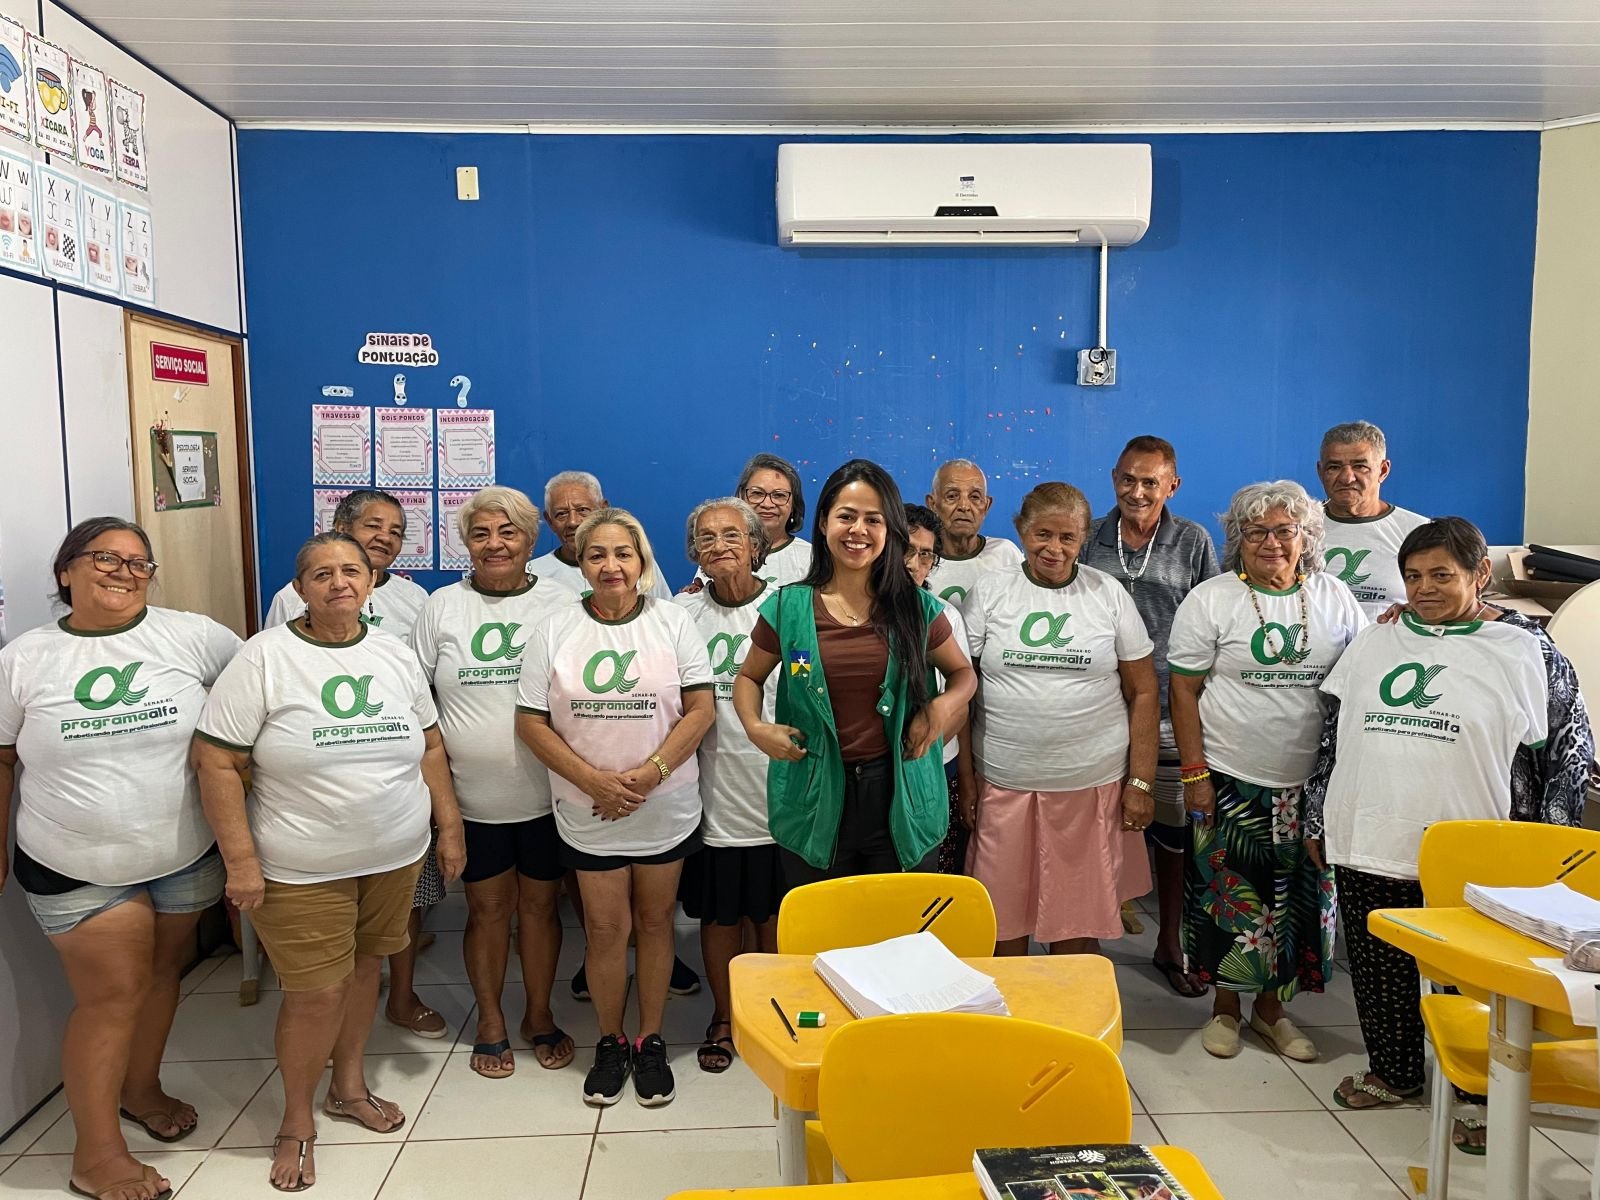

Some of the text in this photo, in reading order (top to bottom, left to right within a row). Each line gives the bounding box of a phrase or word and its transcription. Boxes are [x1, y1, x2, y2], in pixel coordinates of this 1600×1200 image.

[0, 95, 19, 114] I-FI
[85, 145, 105, 161] YOGA
[155, 354, 206, 375] SERVIÇO SOCIAL
[1002, 651, 1092, 665] programaalfa
[458, 666, 522, 680] programa
[1240, 671, 1325, 682] programaalfa
[570, 699, 657, 713] programaalfa
[60, 706, 178, 733] programaalfa
[1364, 713, 1460, 734] programaalfa
[312, 721, 410, 740] programaalfa
